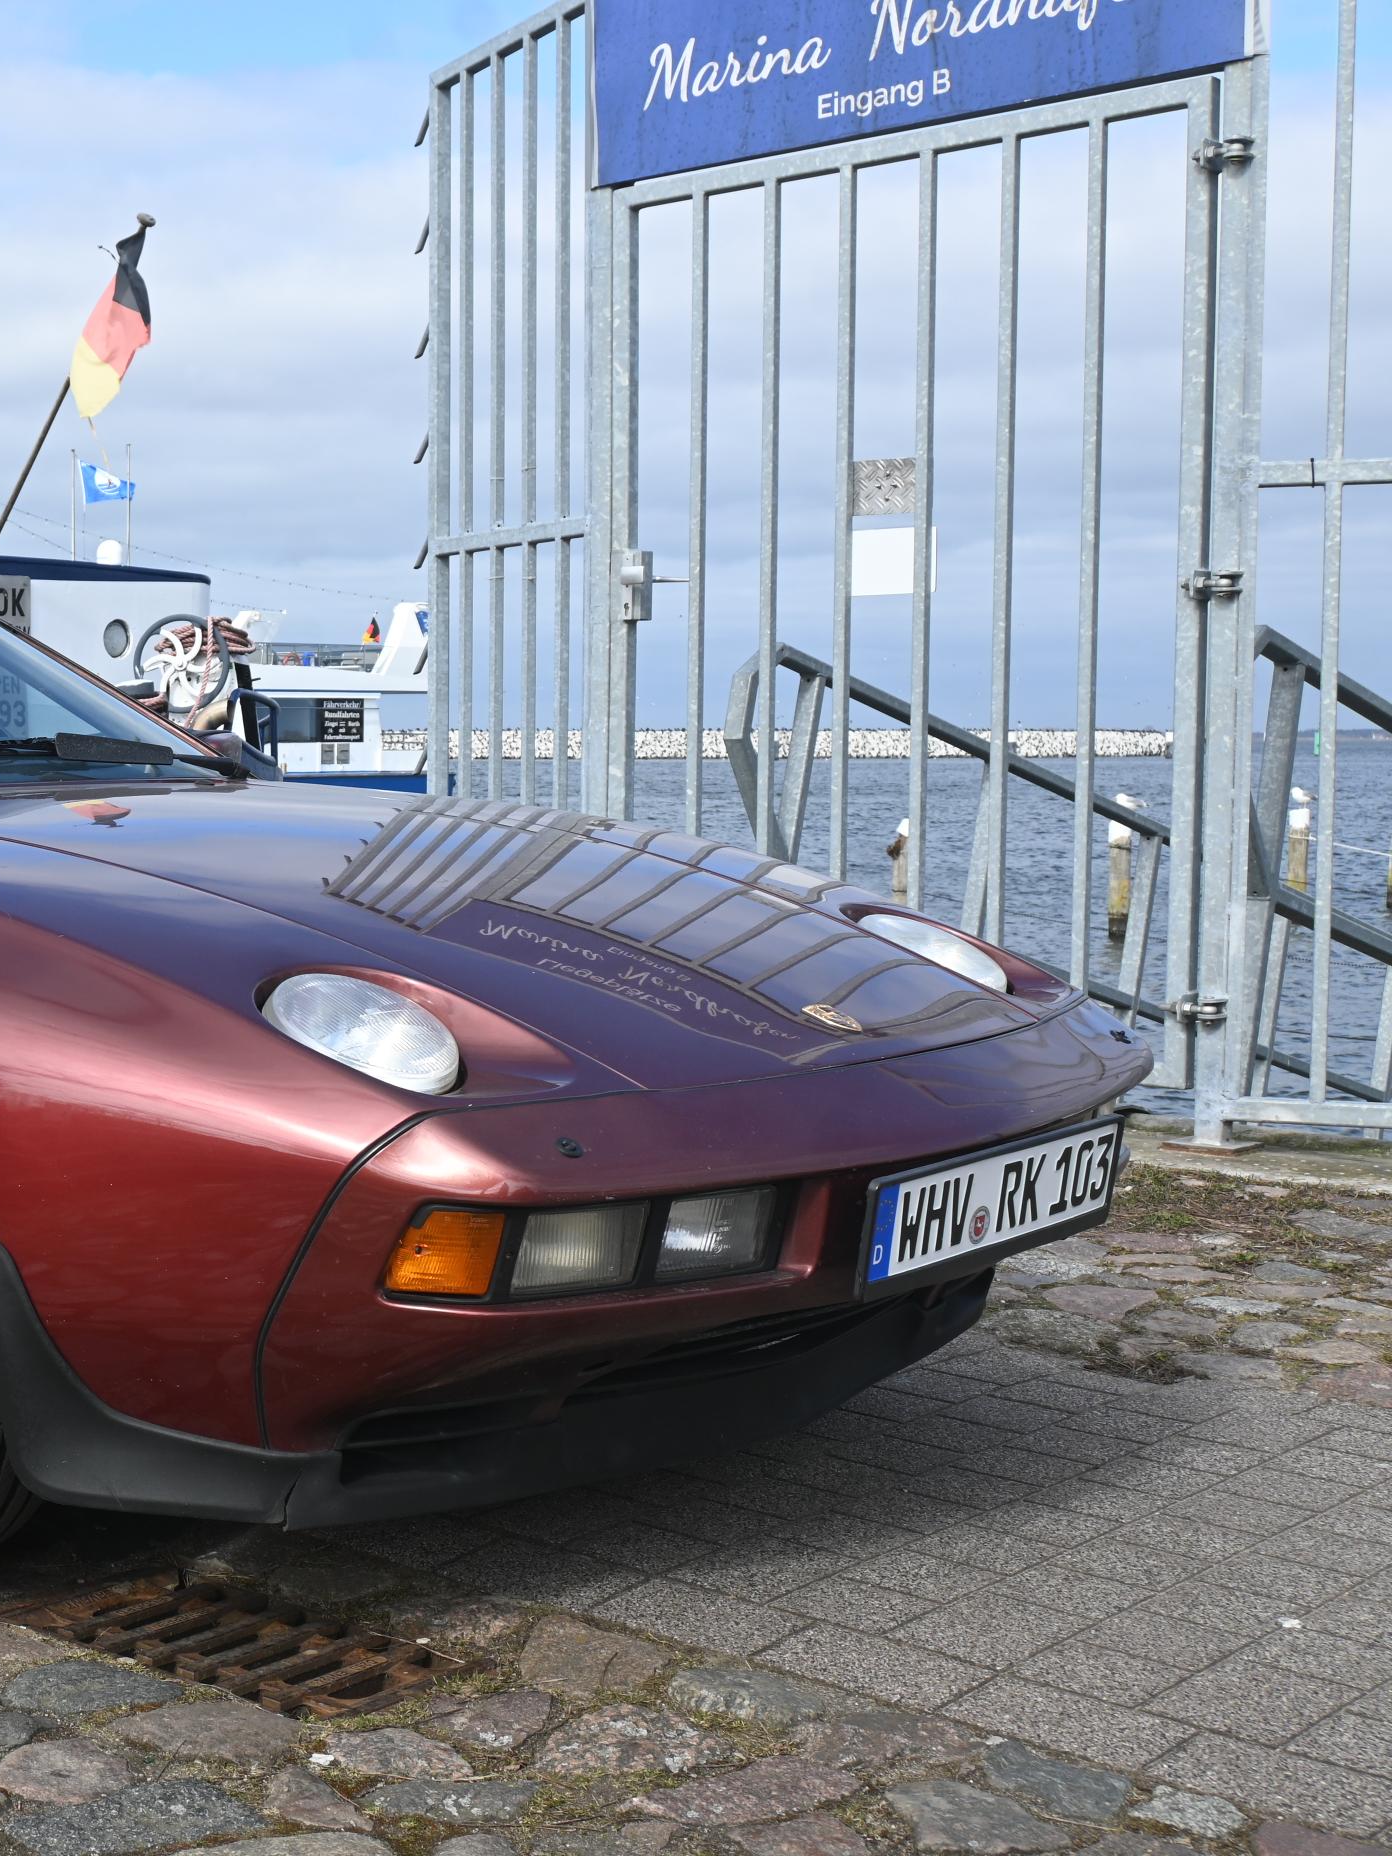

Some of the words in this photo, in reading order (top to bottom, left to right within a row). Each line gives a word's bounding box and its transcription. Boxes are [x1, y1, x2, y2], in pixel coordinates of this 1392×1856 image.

[644, 35, 833, 111] Marina
[816, 76, 926, 120] Eingang
[931, 68, 951, 96] B
[324, 710, 360, 718] Rundfahrten
[898, 1173, 974, 1262] WHV
[995, 1153, 1048, 1233] RK
[1048, 1133, 1114, 1216] 103
[872, 1244, 883, 1264] D
